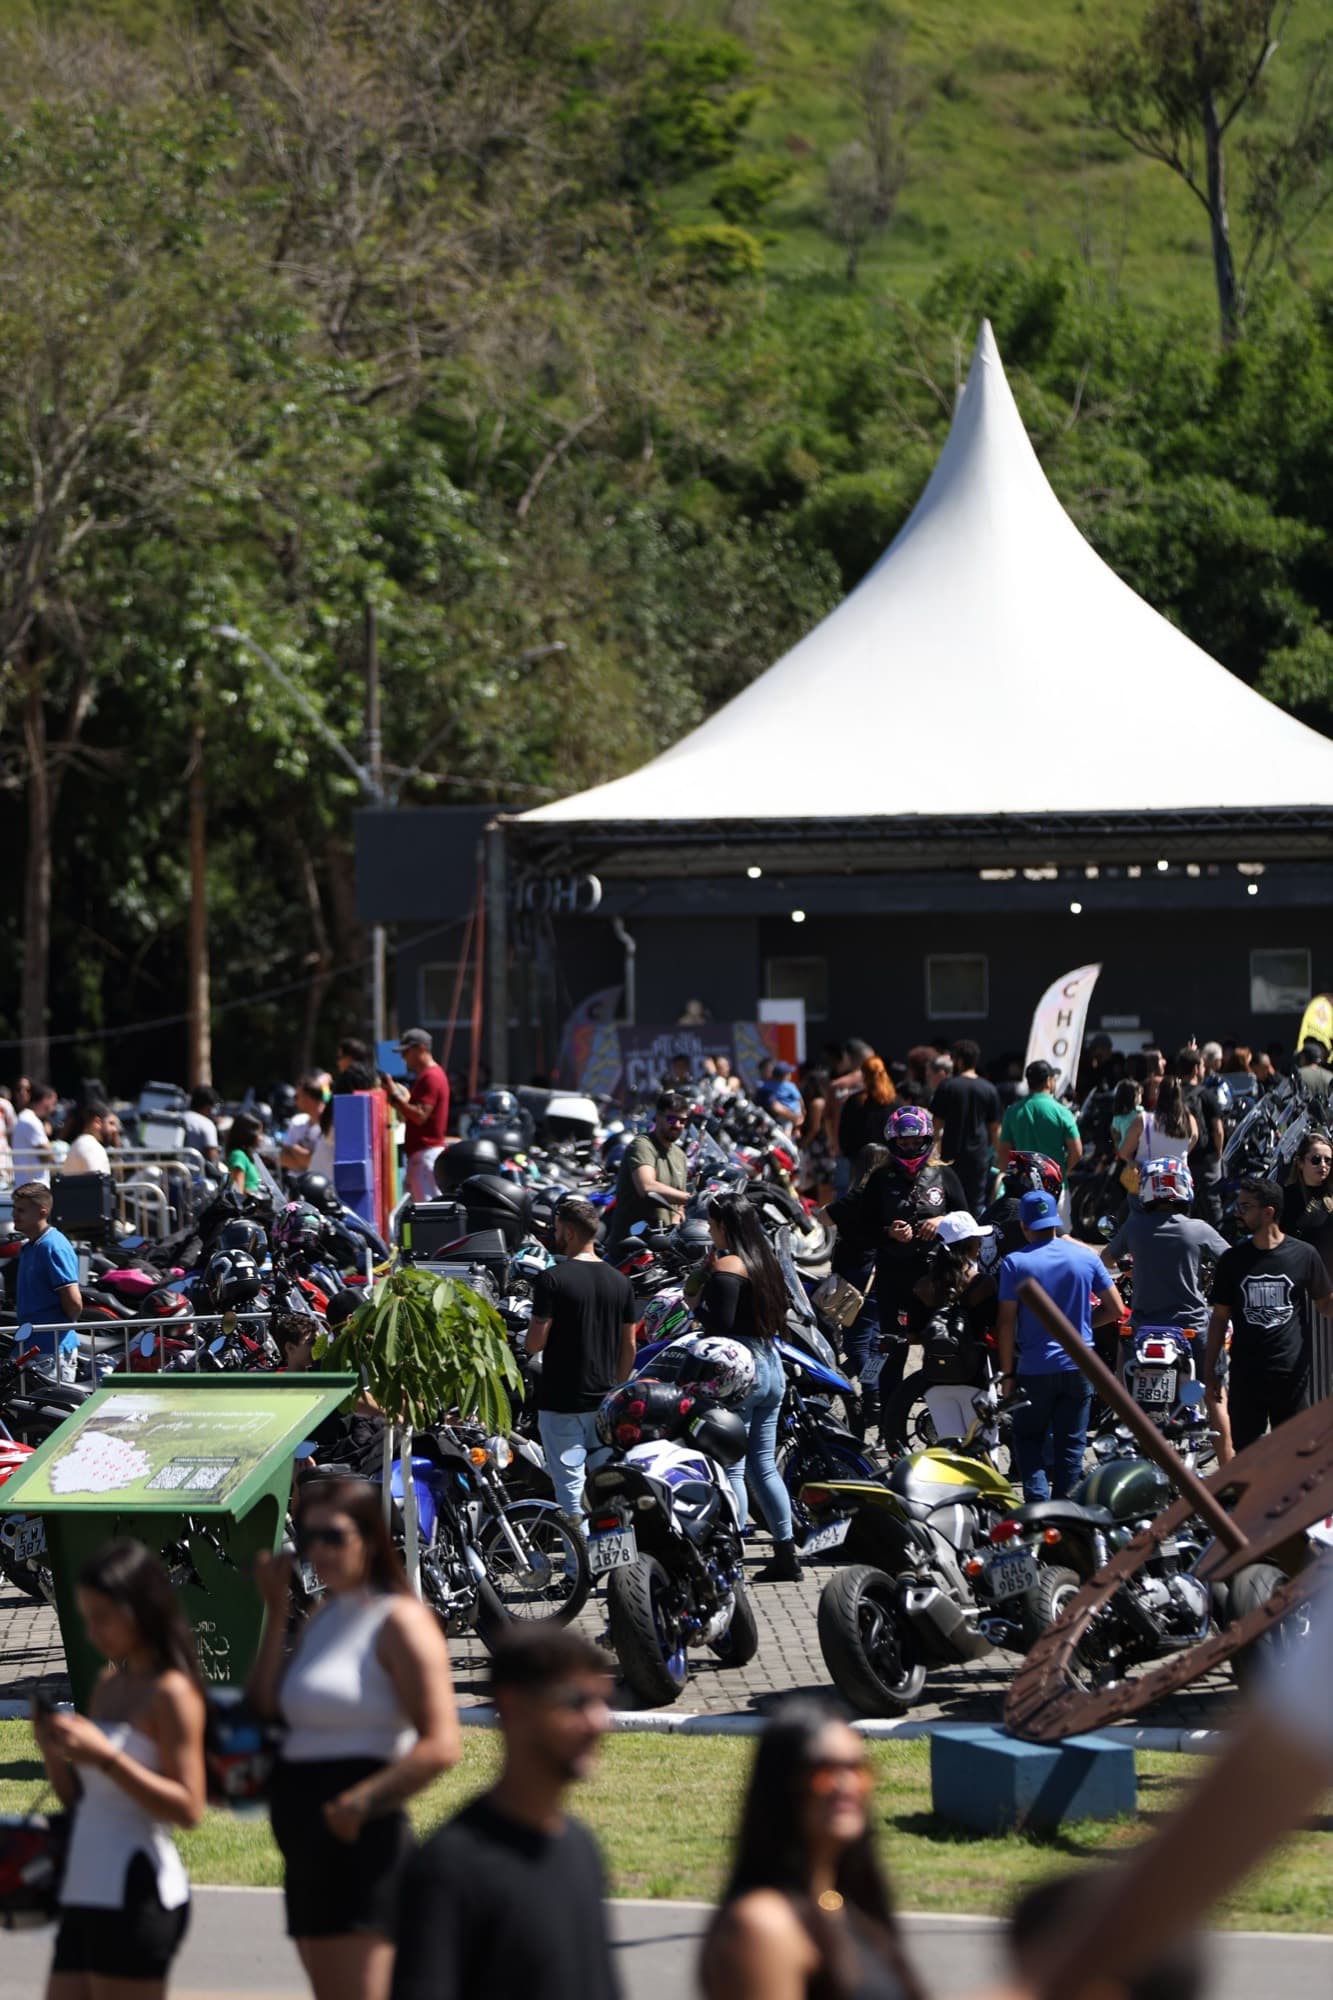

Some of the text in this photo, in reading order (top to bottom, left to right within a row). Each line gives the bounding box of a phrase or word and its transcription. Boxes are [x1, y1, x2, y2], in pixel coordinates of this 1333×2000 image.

[1052, 980, 1080, 1058] CHO
[1138, 1376, 1169, 1390] BVH
[598, 1535, 623, 1553] EZY
